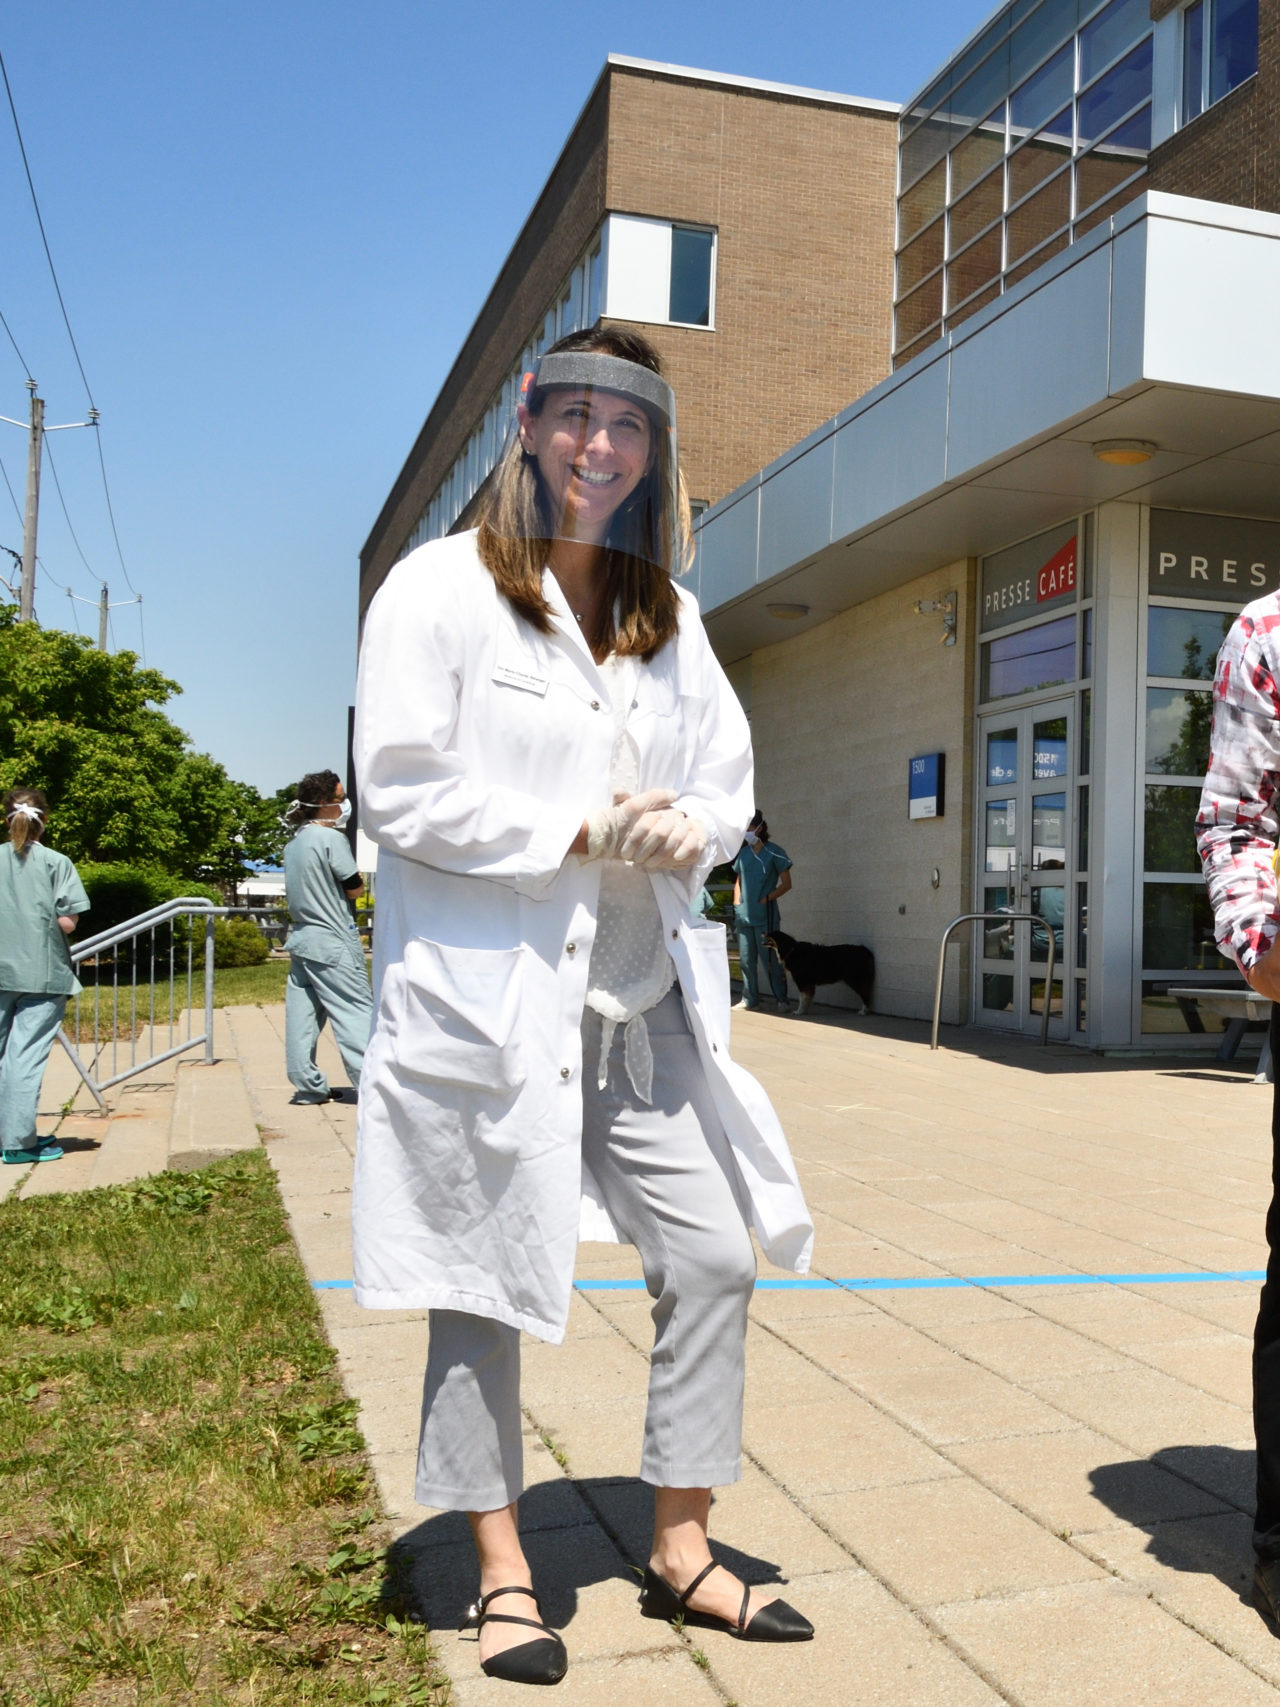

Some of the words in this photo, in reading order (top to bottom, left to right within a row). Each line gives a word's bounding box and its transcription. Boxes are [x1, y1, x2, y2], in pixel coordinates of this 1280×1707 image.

[985, 580, 1030, 615] PRESSE
[1040, 556, 1074, 596] CAFÉ
[912, 760, 925, 775] 1500
